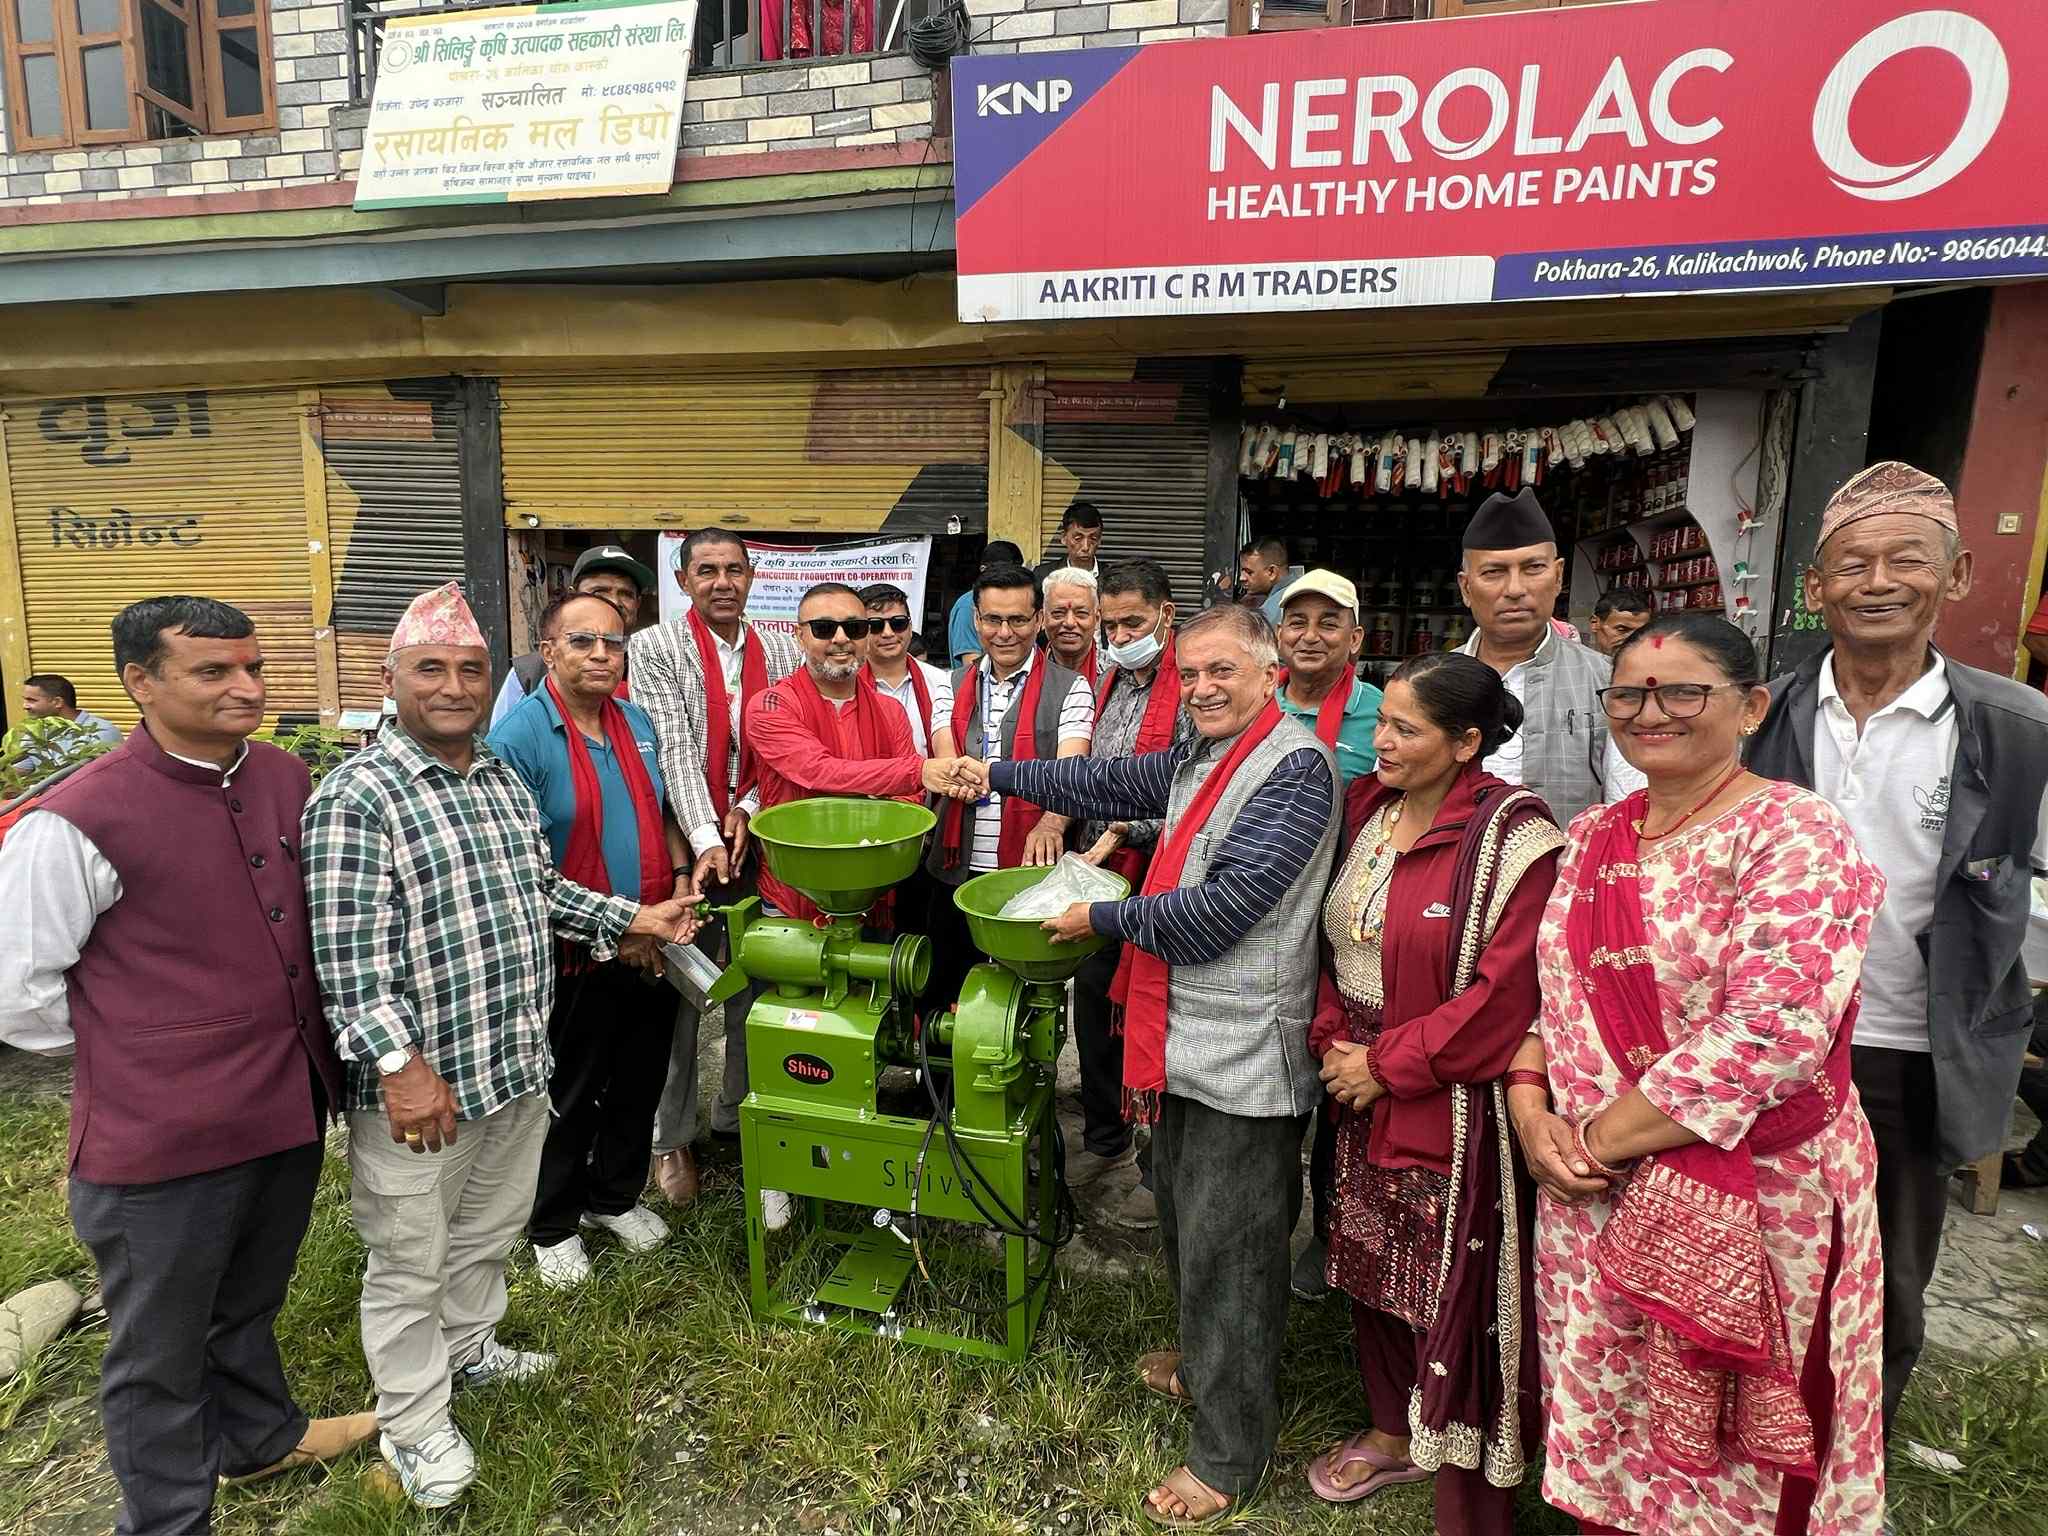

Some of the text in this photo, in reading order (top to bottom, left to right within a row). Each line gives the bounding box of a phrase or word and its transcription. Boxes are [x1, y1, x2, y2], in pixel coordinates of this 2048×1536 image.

[413, 40, 431, 64] श्री
[480, 32, 508, 62] कृषि
[511, 34, 565, 55] उत्पादक
[568, 24, 622, 52] सहकारी
[624, 24, 663, 47] संस्था
[665, 17, 687, 42] लि.
[977, 79, 1073, 117] KNP
[1209, 48, 1734, 172] NEROLAC
[373, 104, 675, 164] रसायनिक मल डिपो
[1207, 157, 1718, 221] HEALTHY HOME PAINTS
[1534, 255, 1661, 283] Pokhara-26,
[1665, 247, 1808, 276] Kalikachwok,
[1813, 244, 1883, 268] Phone
[1888, 241, 1937, 264] No:-
[1039, 265, 1398, 304] AAKRITI C R M TRADERS
[800, 571, 846, 581] PRODUCTIVE
[847, 571, 900, 581] CO-OPERATIVE
[871, 552, 898, 566] संस्था
[787, 1058, 830, 1081] Shiva
